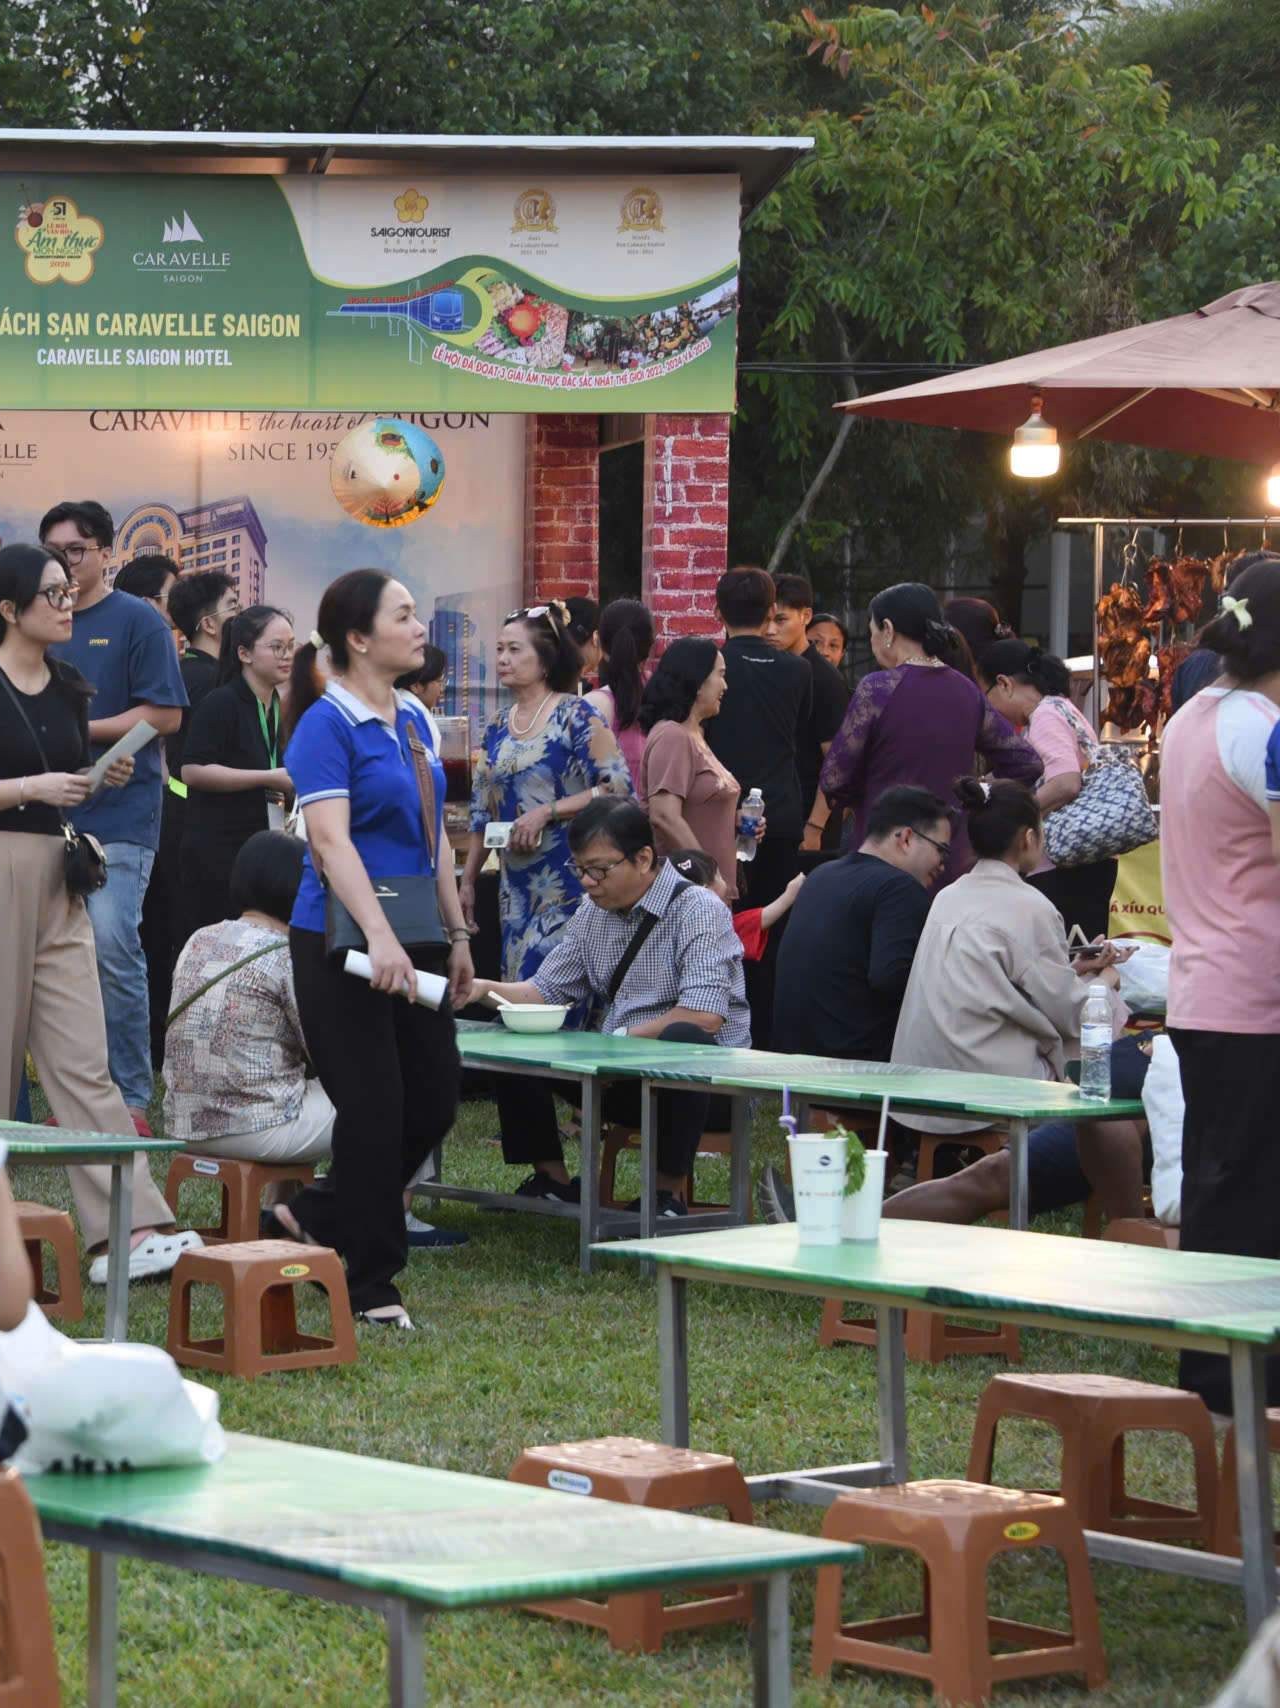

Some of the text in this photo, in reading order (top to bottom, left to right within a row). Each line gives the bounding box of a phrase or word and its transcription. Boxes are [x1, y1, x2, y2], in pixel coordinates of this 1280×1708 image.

[370, 227, 451, 237] SAIGONTOURIST
[133, 253, 231, 266] CARAVELLE
[163, 275, 203, 283] SAIGON
[47, 312, 89, 343] SẠN
[96, 313, 216, 337] CARAVELLE
[222, 314, 300, 337] SAIGON
[37, 348, 233, 366] CARAVELLE SAIGON HOTEL
[445, 352, 461, 368] HỘI
[462, 355, 474, 370] ĐÃ
[475, 362, 498, 378] ĐOẠT
[500, 368, 505, 378] 3
[507, 367, 523, 381] GIẢI
[541, 374, 560, 389] THỰC
[561, 373, 577, 390] ĐẶC
[579, 371, 592, 387] SẮC
[594, 372, 614, 386] NHẤT
[615, 369, 628, 384] THẾ
[665, 358, 682, 371] 2024
[682, 345, 693, 361] VÀ
[693, 337, 711, 355] 2025
[90, 410, 251, 431] CARAVELLE
[260, 411, 286, 431] the
[290, 411, 344, 431] heart
[228, 442, 338, 461] SINCE 195
[1122, 901, 1145, 913] XÍU
